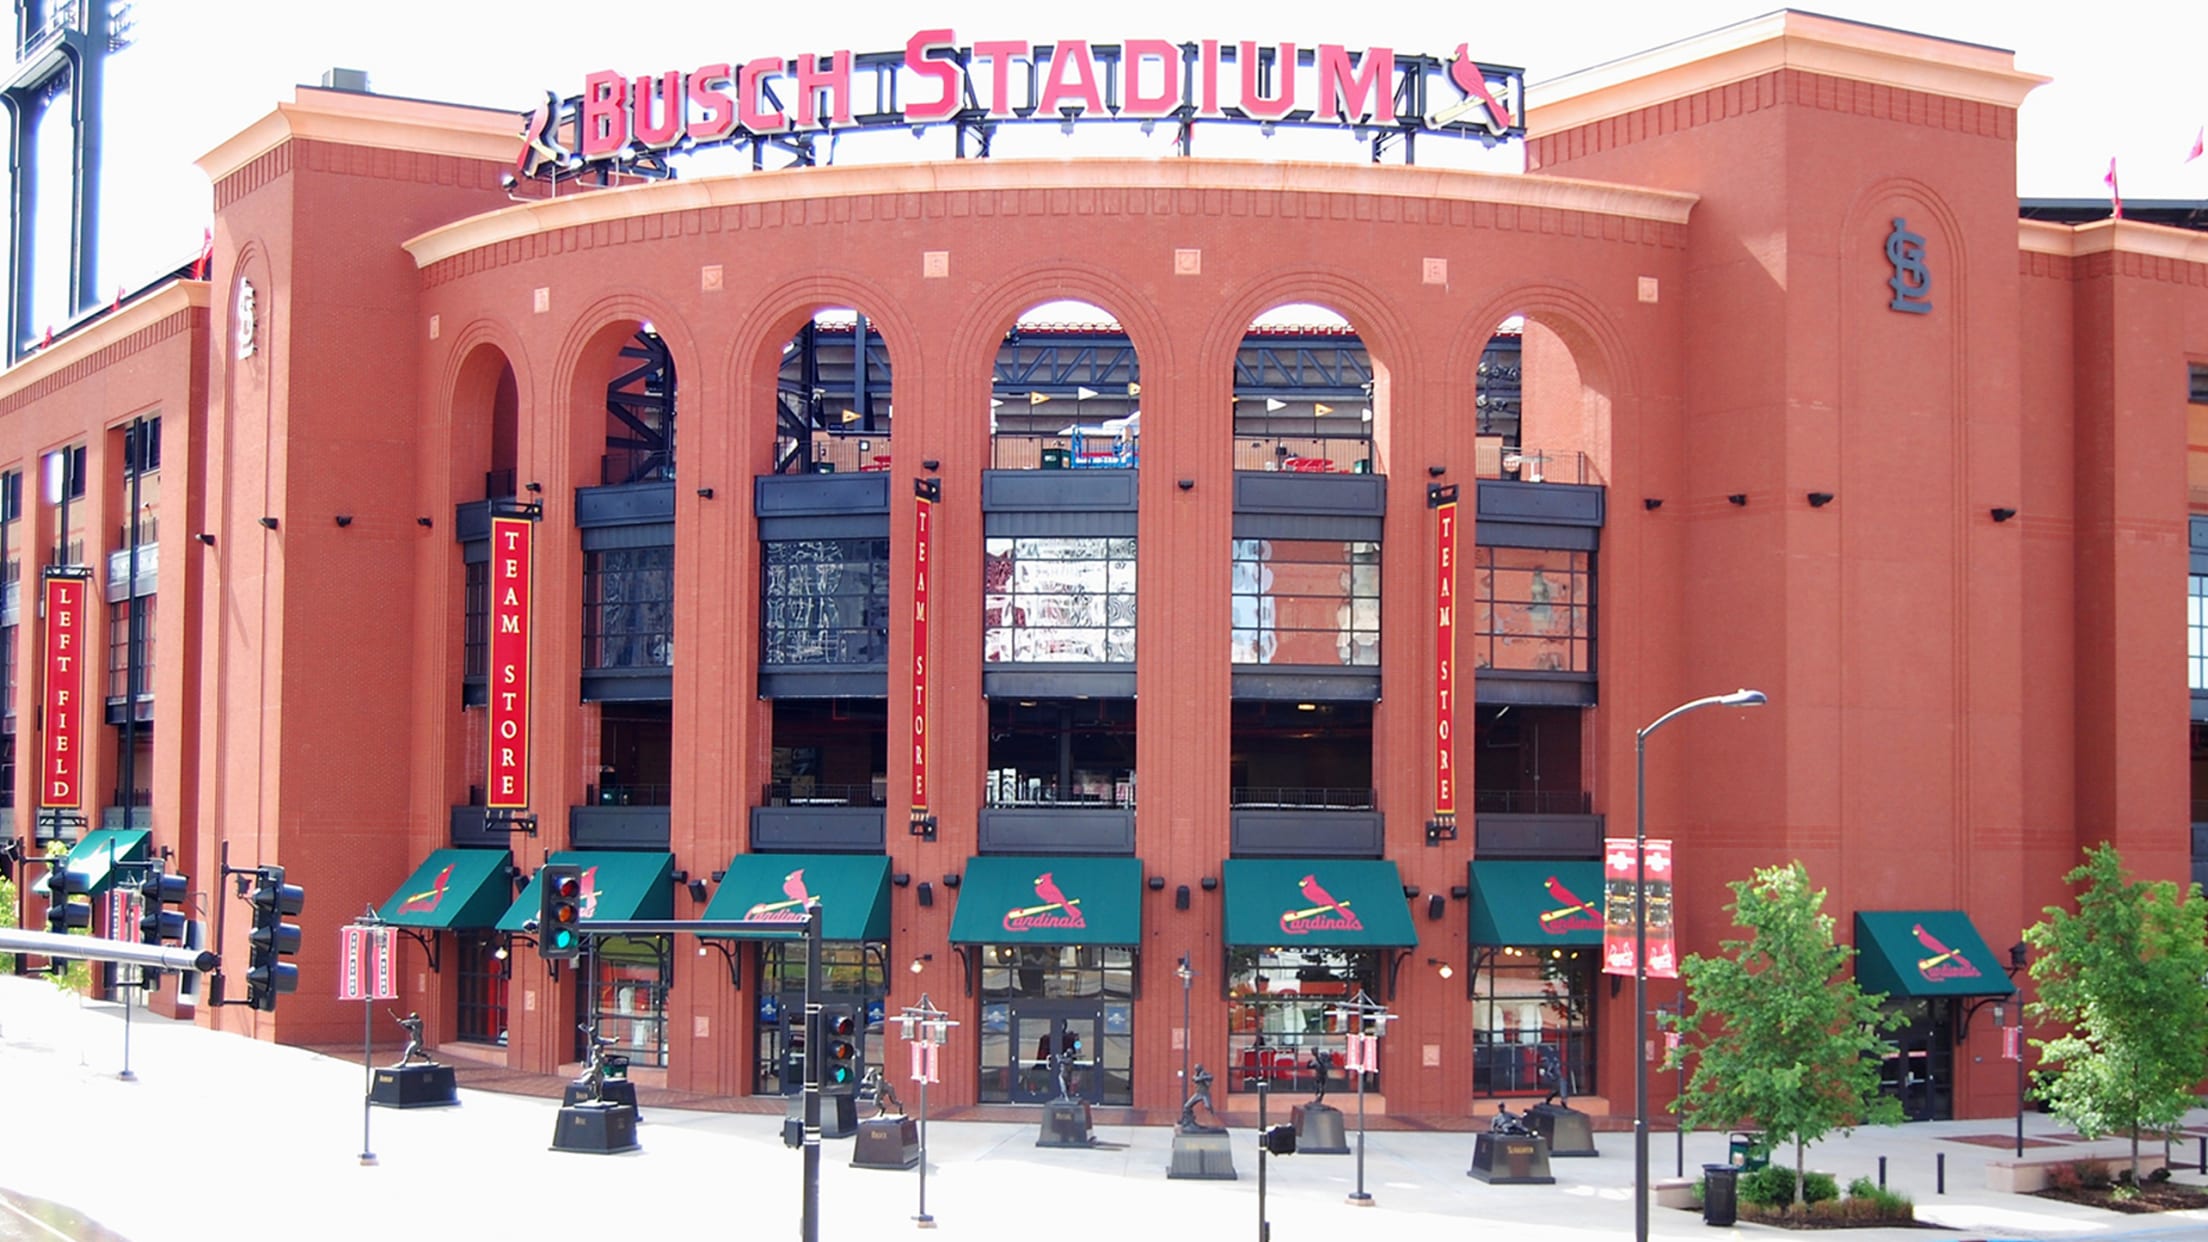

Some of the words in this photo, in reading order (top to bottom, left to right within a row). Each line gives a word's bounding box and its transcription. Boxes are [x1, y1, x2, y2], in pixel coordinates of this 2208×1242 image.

[582, 49, 853, 157] BUSCH
[904, 28, 1397, 123] STADIUM
[501, 531, 520, 634] TEAM
[915, 511, 928, 622] TEAM
[1438, 517, 1451, 627] TEAM
[56, 587, 72, 673] LEFT
[53, 690, 70, 799] FIELD
[500, 664, 518, 795] STORE
[914, 654, 925, 796] STORE
[1438, 660, 1450, 801] STORE
[1003, 907, 1087, 932] Cardinals
[1280, 910, 1364, 934] Cardinals
